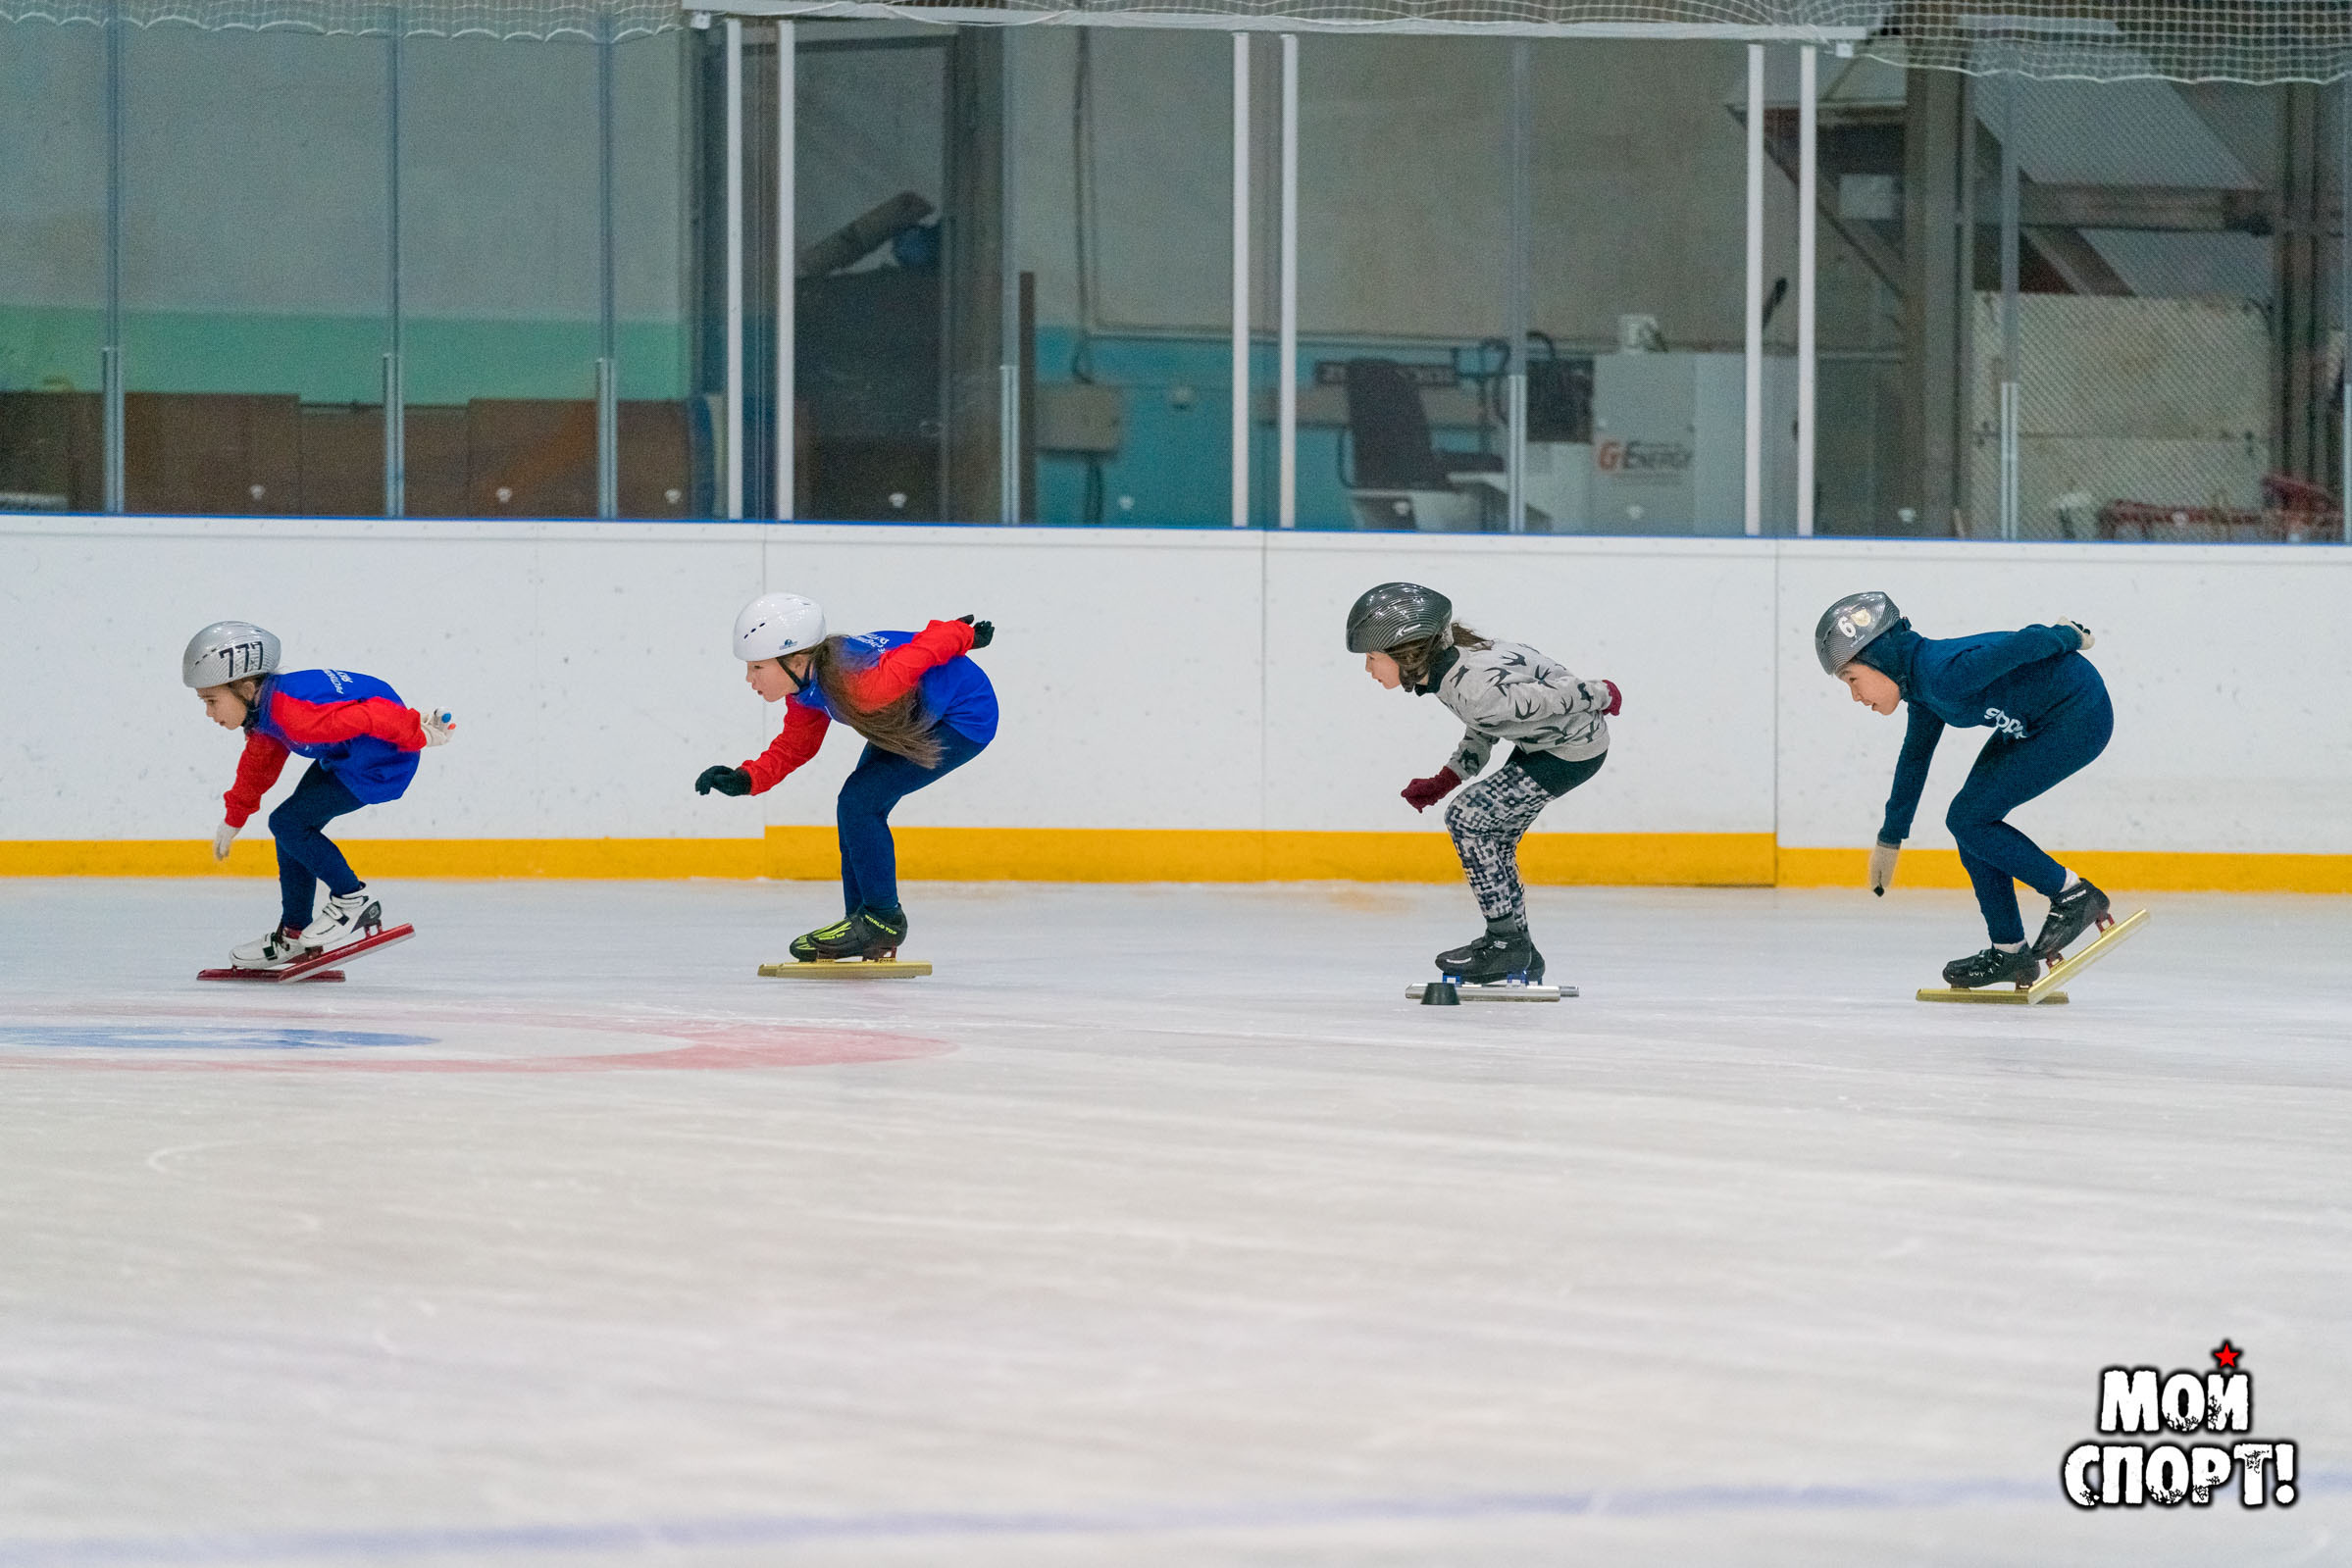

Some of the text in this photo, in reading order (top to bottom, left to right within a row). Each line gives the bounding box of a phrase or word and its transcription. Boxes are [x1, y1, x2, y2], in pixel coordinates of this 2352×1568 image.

[219, 640, 264, 678] 777
[865, 914, 897, 935] WORLD TOP
